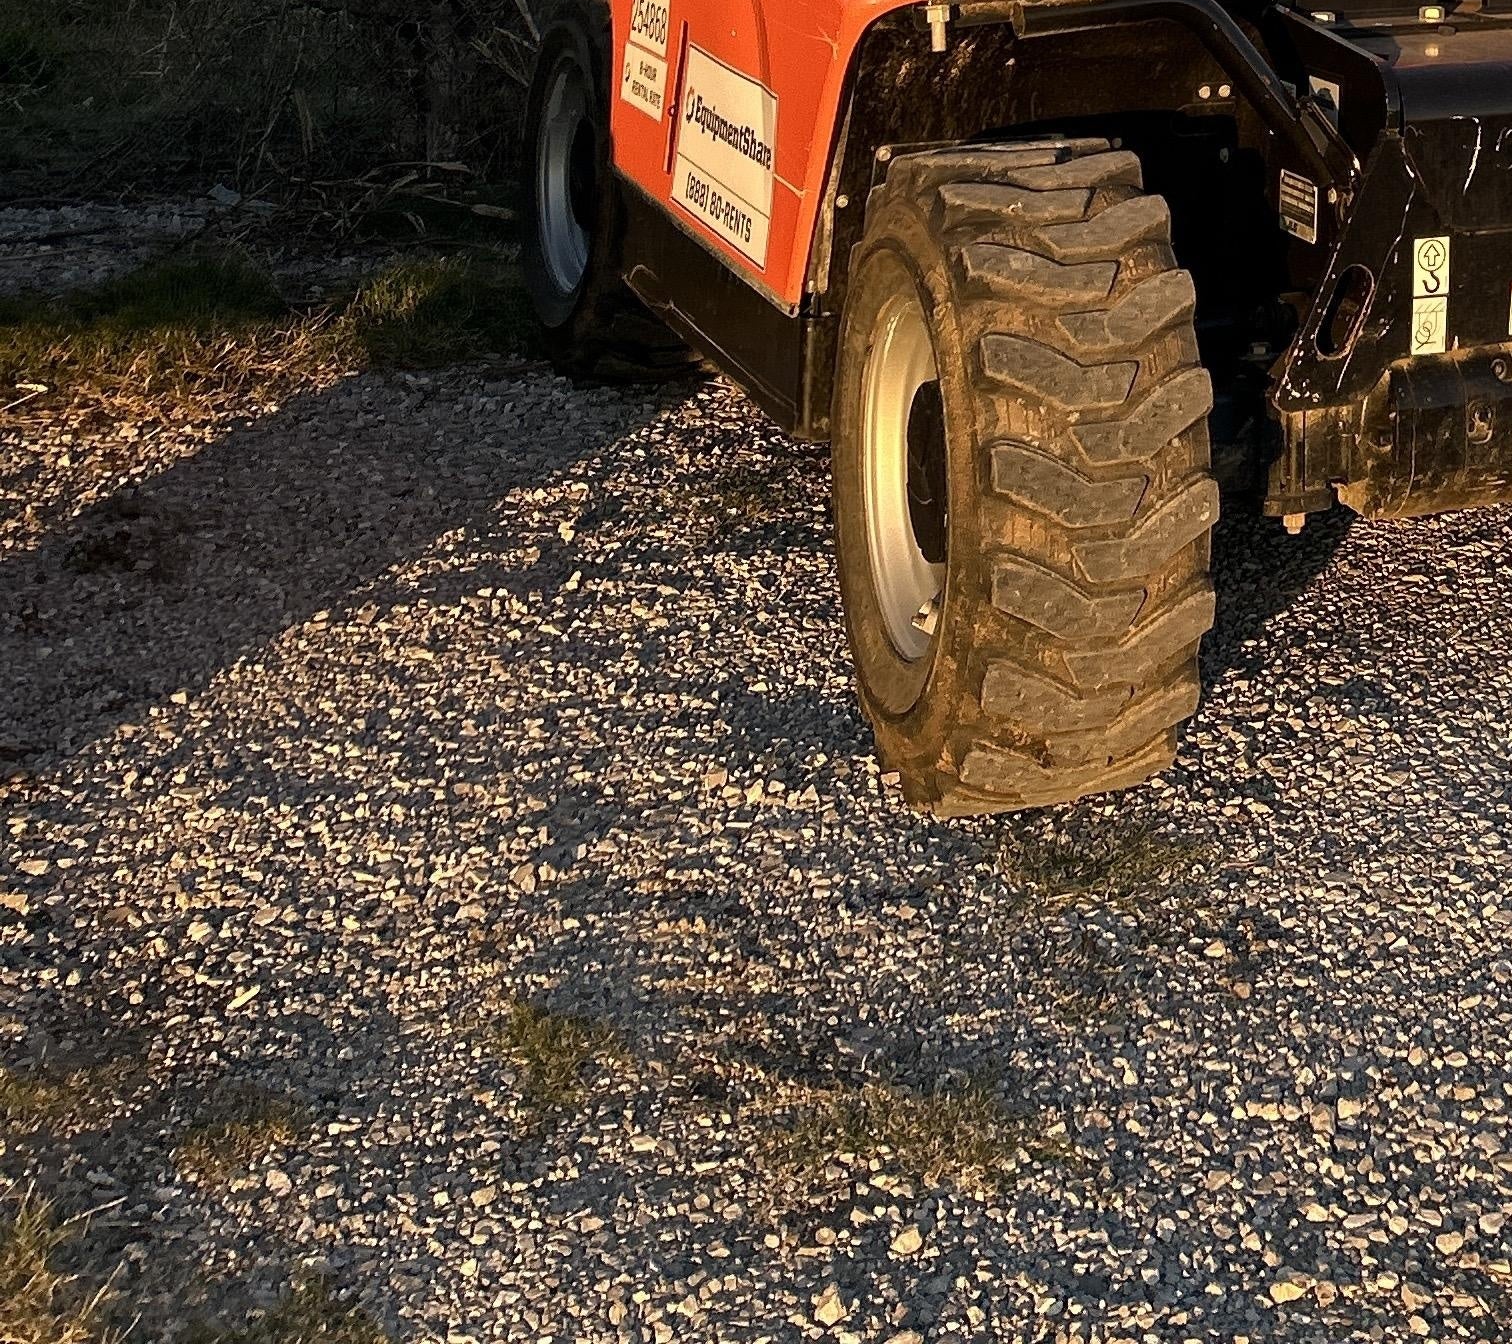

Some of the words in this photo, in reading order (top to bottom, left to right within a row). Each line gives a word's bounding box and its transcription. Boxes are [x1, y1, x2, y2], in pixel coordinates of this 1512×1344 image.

[694, 94, 772, 171] EquipmentShare
[685, 171, 710, 213] (888)
[709, 190, 753, 243] 80-RENTS
